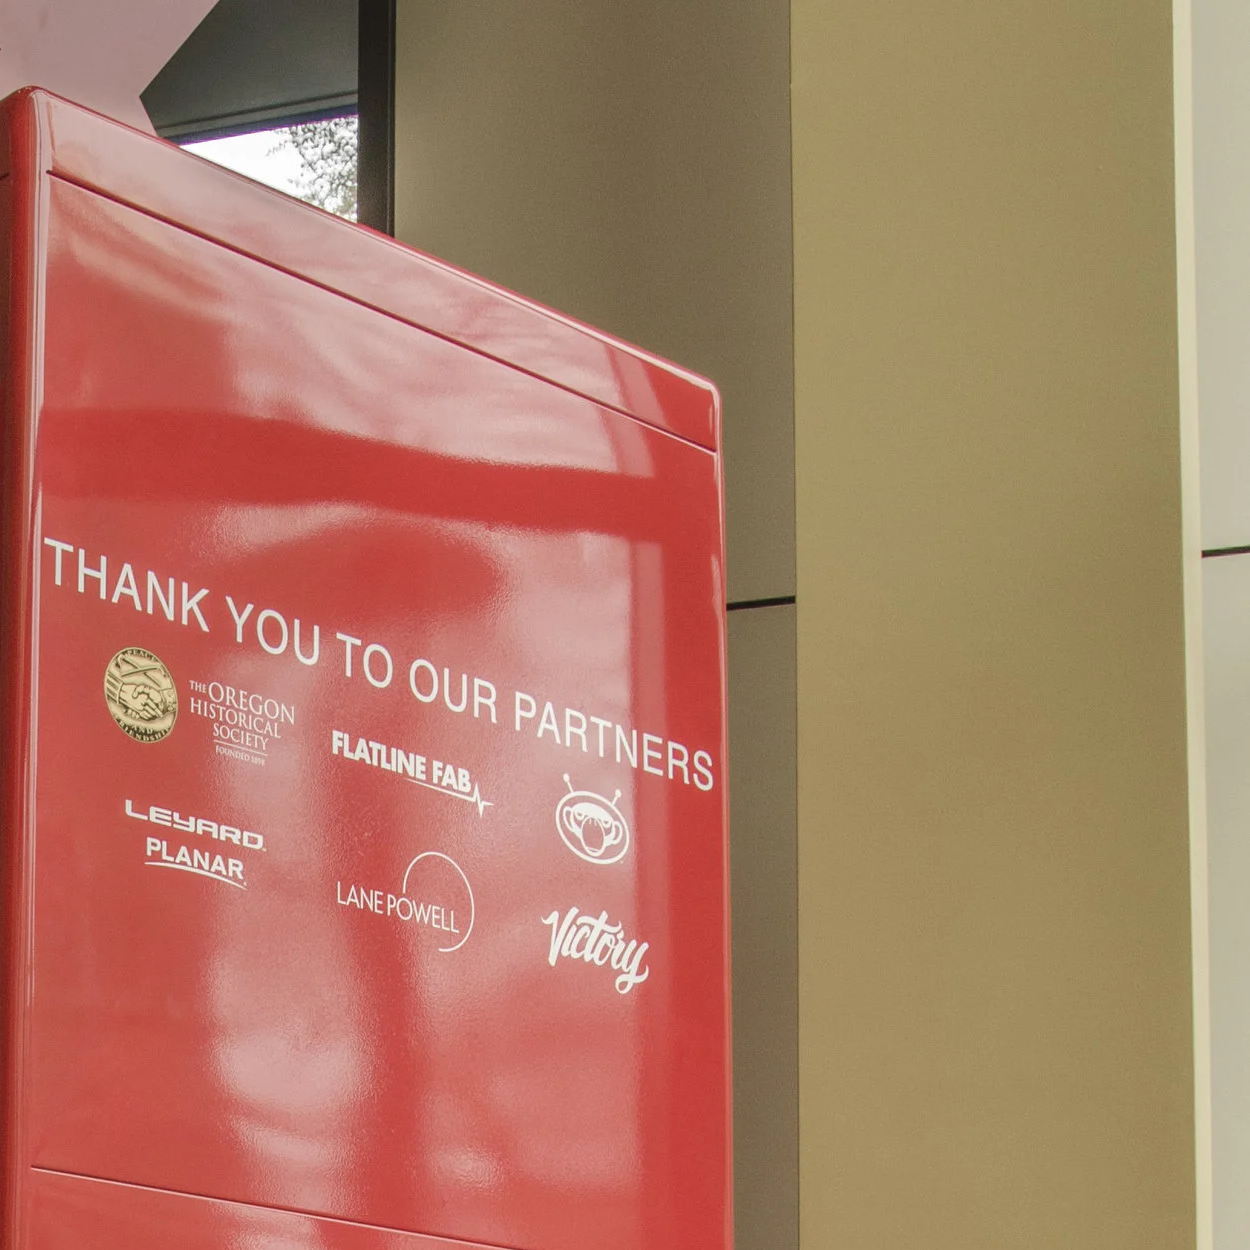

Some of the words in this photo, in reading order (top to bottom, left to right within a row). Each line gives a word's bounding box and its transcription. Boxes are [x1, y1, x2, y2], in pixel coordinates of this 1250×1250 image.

[43, 537, 210, 633] THANK
[225, 595, 320, 667] YOU
[336, 631, 394, 689] TO
[409, 658, 498, 724] OUR
[514, 691, 714, 792] PARTNERS
[189, 679, 207, 694] THE
[208, 681, 296, 726] OREGON
[190, 696, 282, 740] HISTORICAL
[213, 722, 269, 751] SOCIETY
[215, 744, 251, 762] FOUNDED
[332, 729, 427, 781] FLATLINE
[432, 759, 472, 794] FAB
[125, 799, 264, 850] LEYARD
[146, 836, 244, 880] PLANAR
[337, 881, 384, 914] LANE
[387, 893, 460, 934] POWELL
[541, 906, 649, 994] Victory
